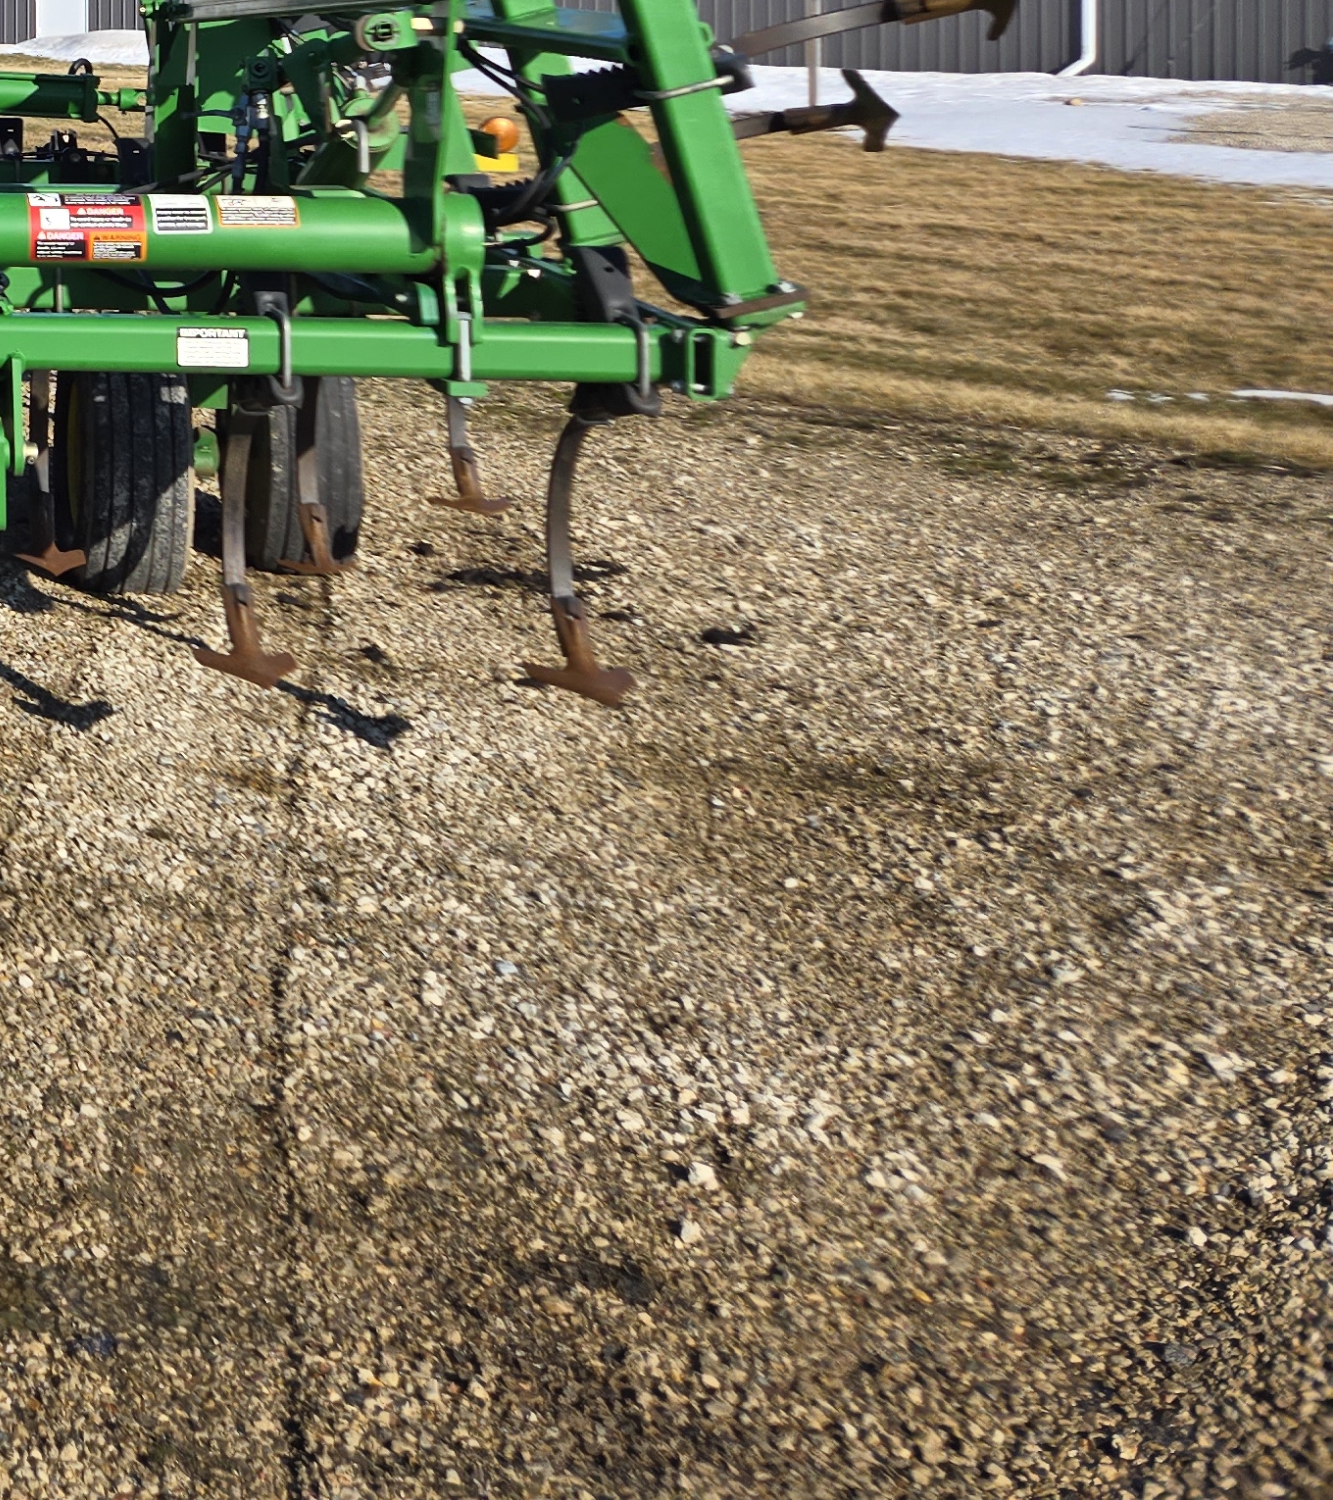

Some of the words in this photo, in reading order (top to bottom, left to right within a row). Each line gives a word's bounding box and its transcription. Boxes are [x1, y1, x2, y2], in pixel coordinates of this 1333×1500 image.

[86, 207, 124, 215] DANGER
[46, 231, 84, 240] DANGER
[179, 328, 246, 338] IMPORTANT
